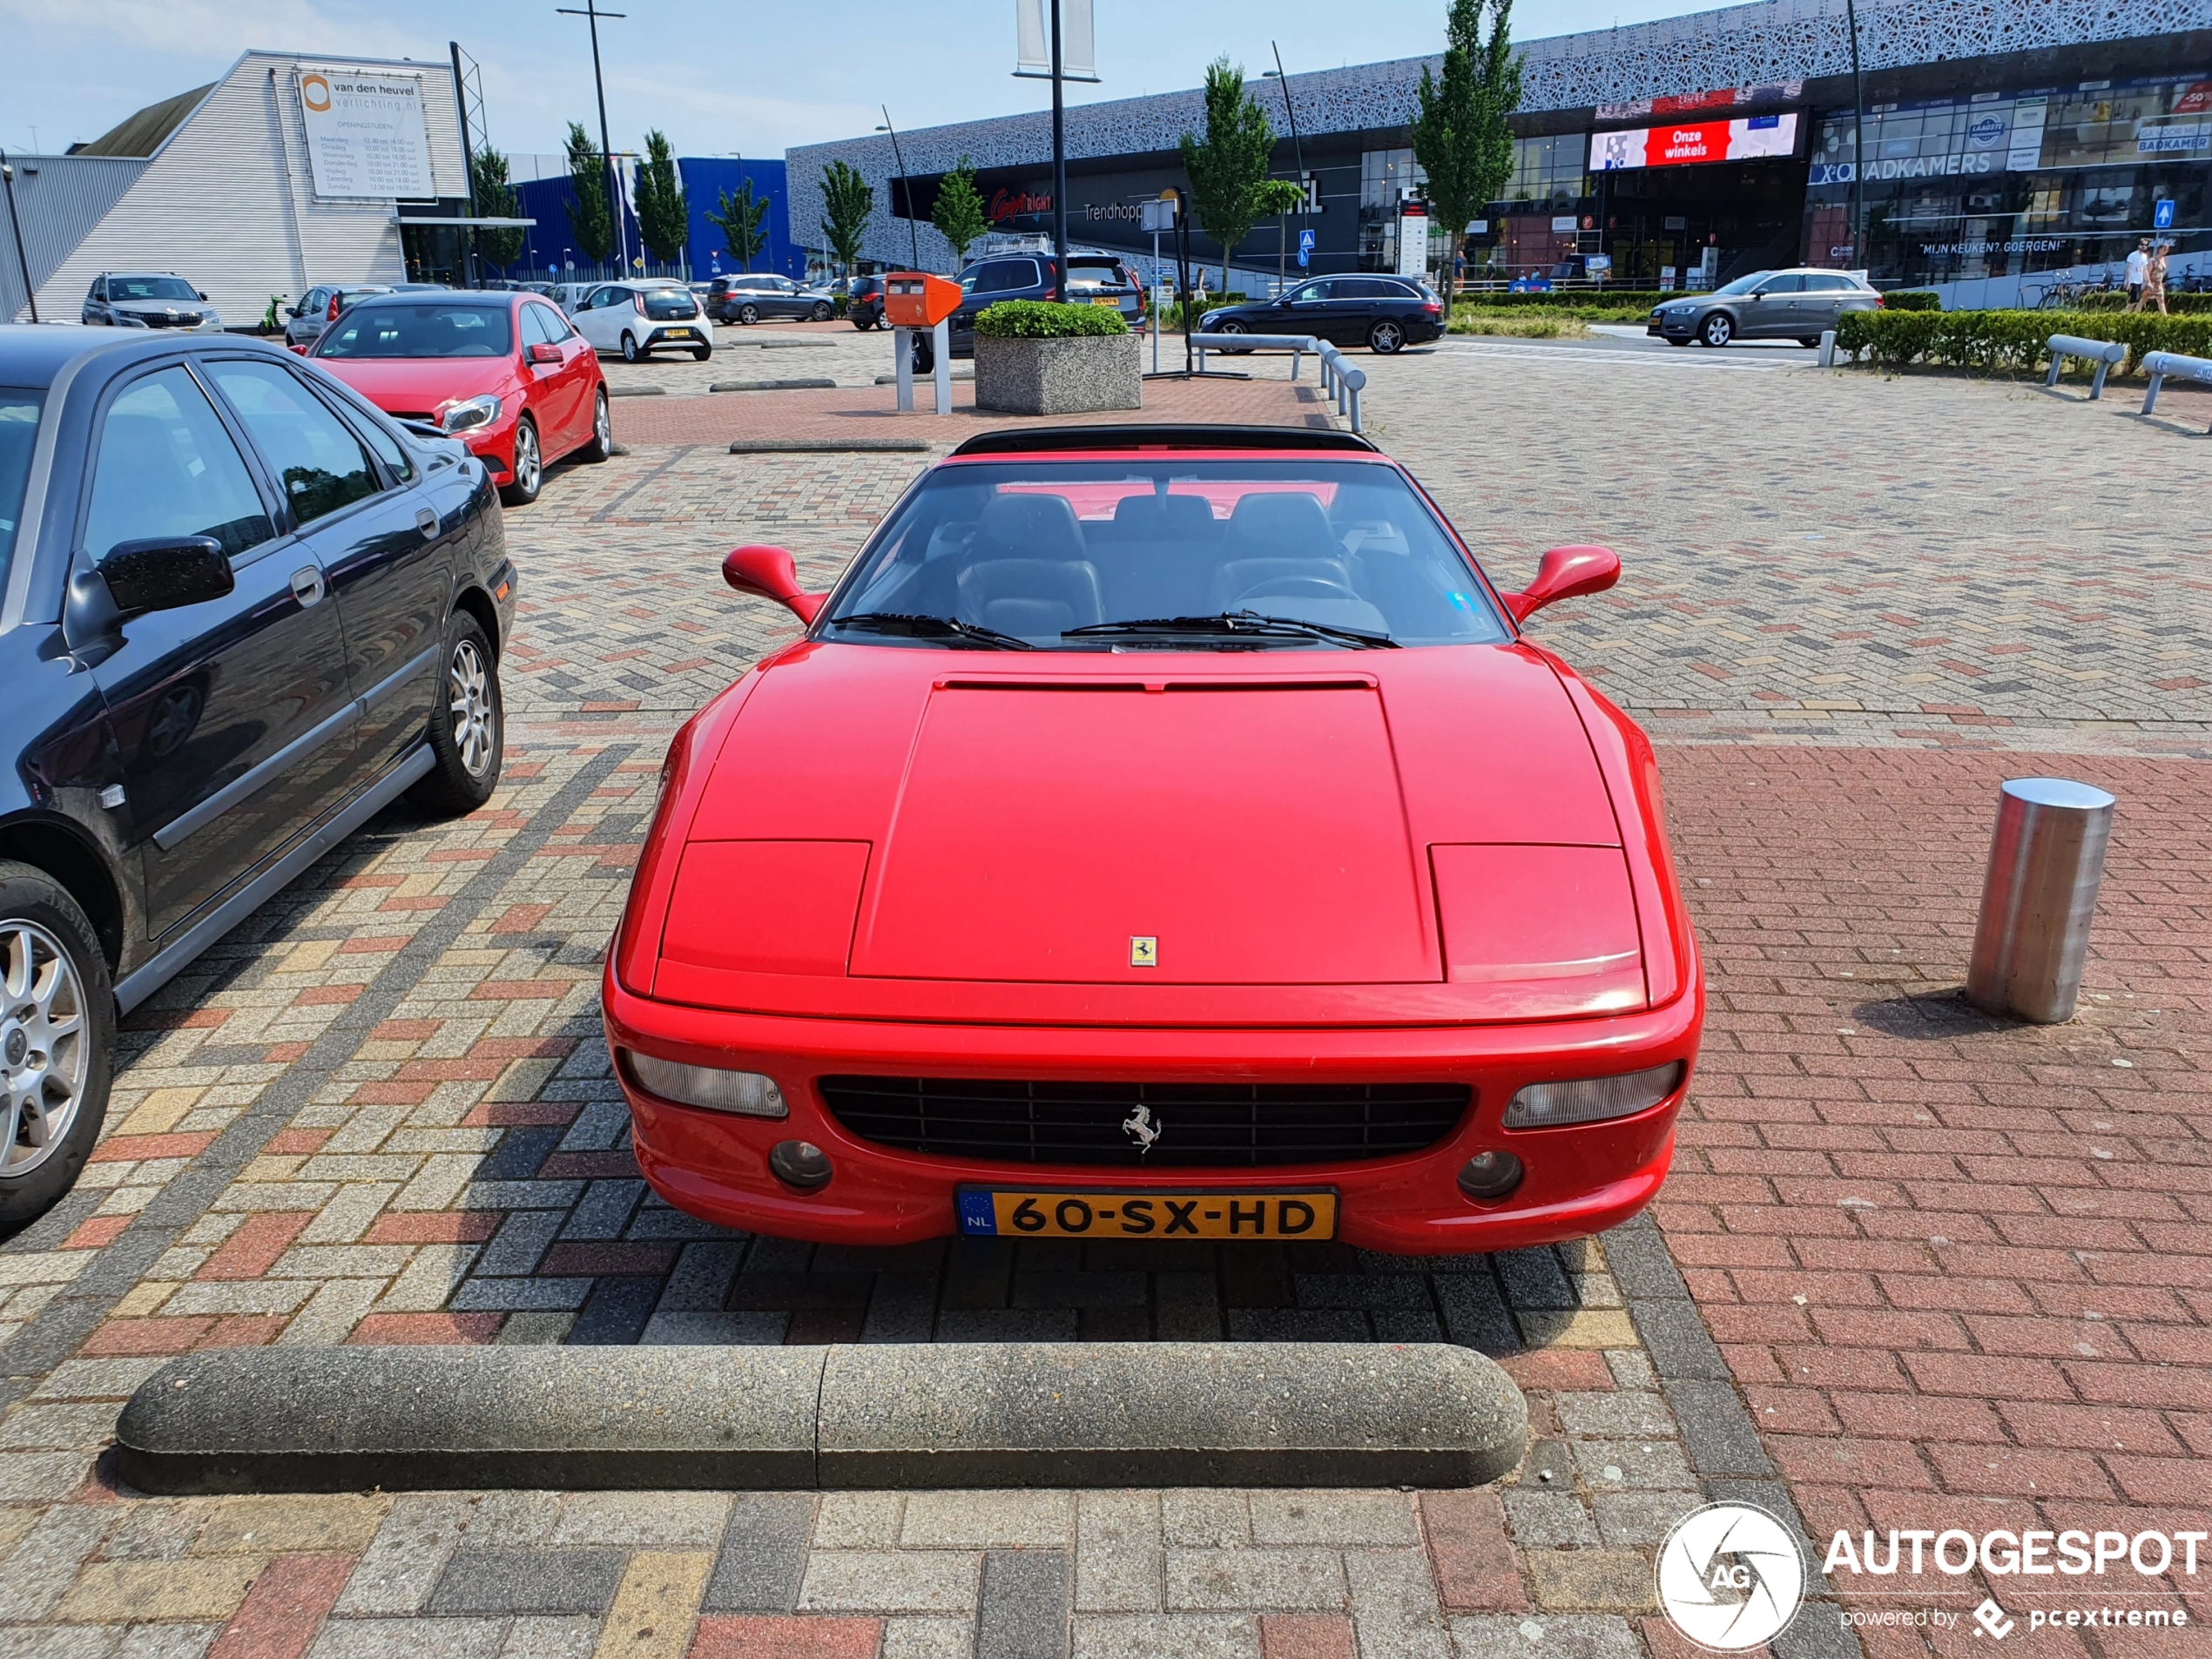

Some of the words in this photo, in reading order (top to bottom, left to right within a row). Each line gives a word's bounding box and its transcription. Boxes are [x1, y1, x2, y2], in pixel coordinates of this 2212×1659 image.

[334, 84, 354, 92] van
[356, 84, 377, 93] den
[379, 84, 415, 96] heuvel
[334, 98, 417, 112] verlichting.nl
[1972, 123, 2003, 132] LAAGSTE
[2141, 130, 2153, 138] GA
[1672, 130, 1703, 144] Onze
[1664, 143, 1708, 159] winkels
[2139, 138, 2207, 152] BADKAMER
[1853, 152, 1992, 182] BADKAMERS
[1950, 241, 2000, 253] KEUKEN?
[968, 1216, 992, 1227] NL
[1011, 1197, 1316, 1235] 60-SX-HD
